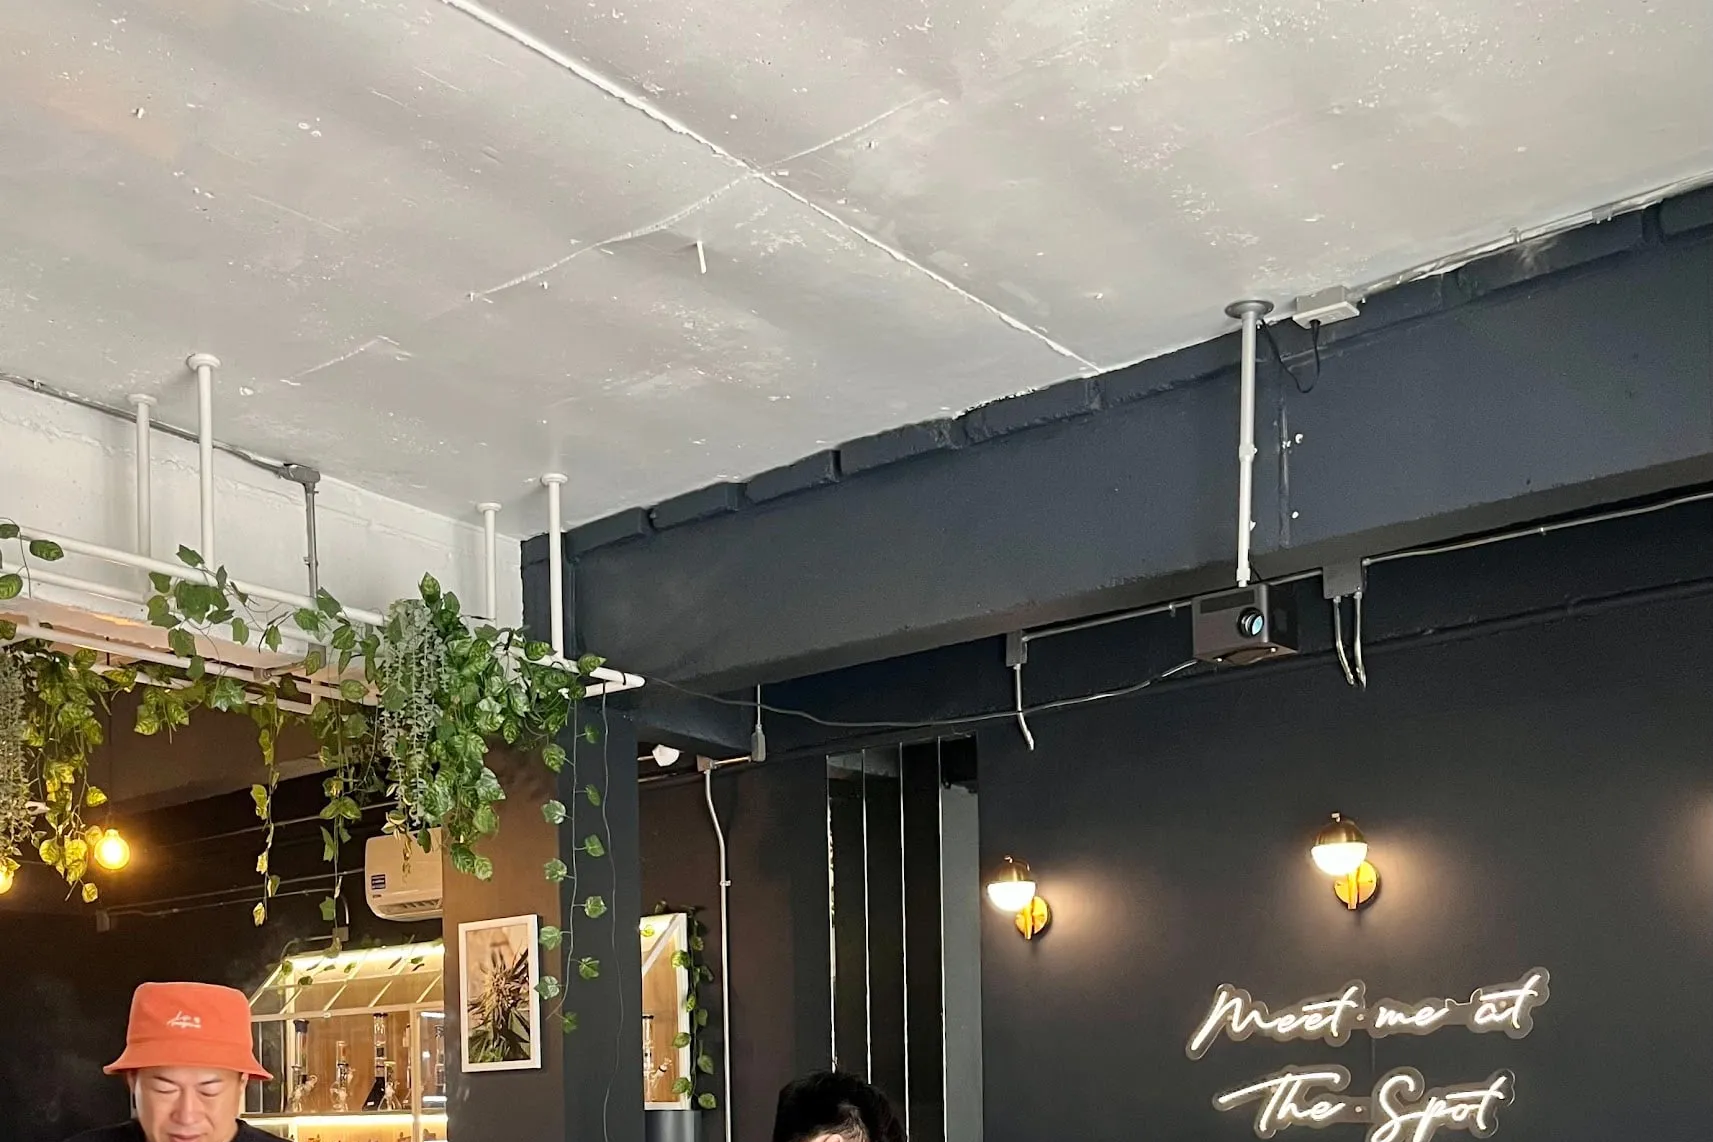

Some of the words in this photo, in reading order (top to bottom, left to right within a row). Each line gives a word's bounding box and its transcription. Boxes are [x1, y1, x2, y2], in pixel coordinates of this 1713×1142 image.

[1189, 984, 1359, 1052] Meet
[1374, 1003, 1448, 1029] me
[1473, 973, 1542, 1030] at
[1217, 1071, 1346, 1133] The
